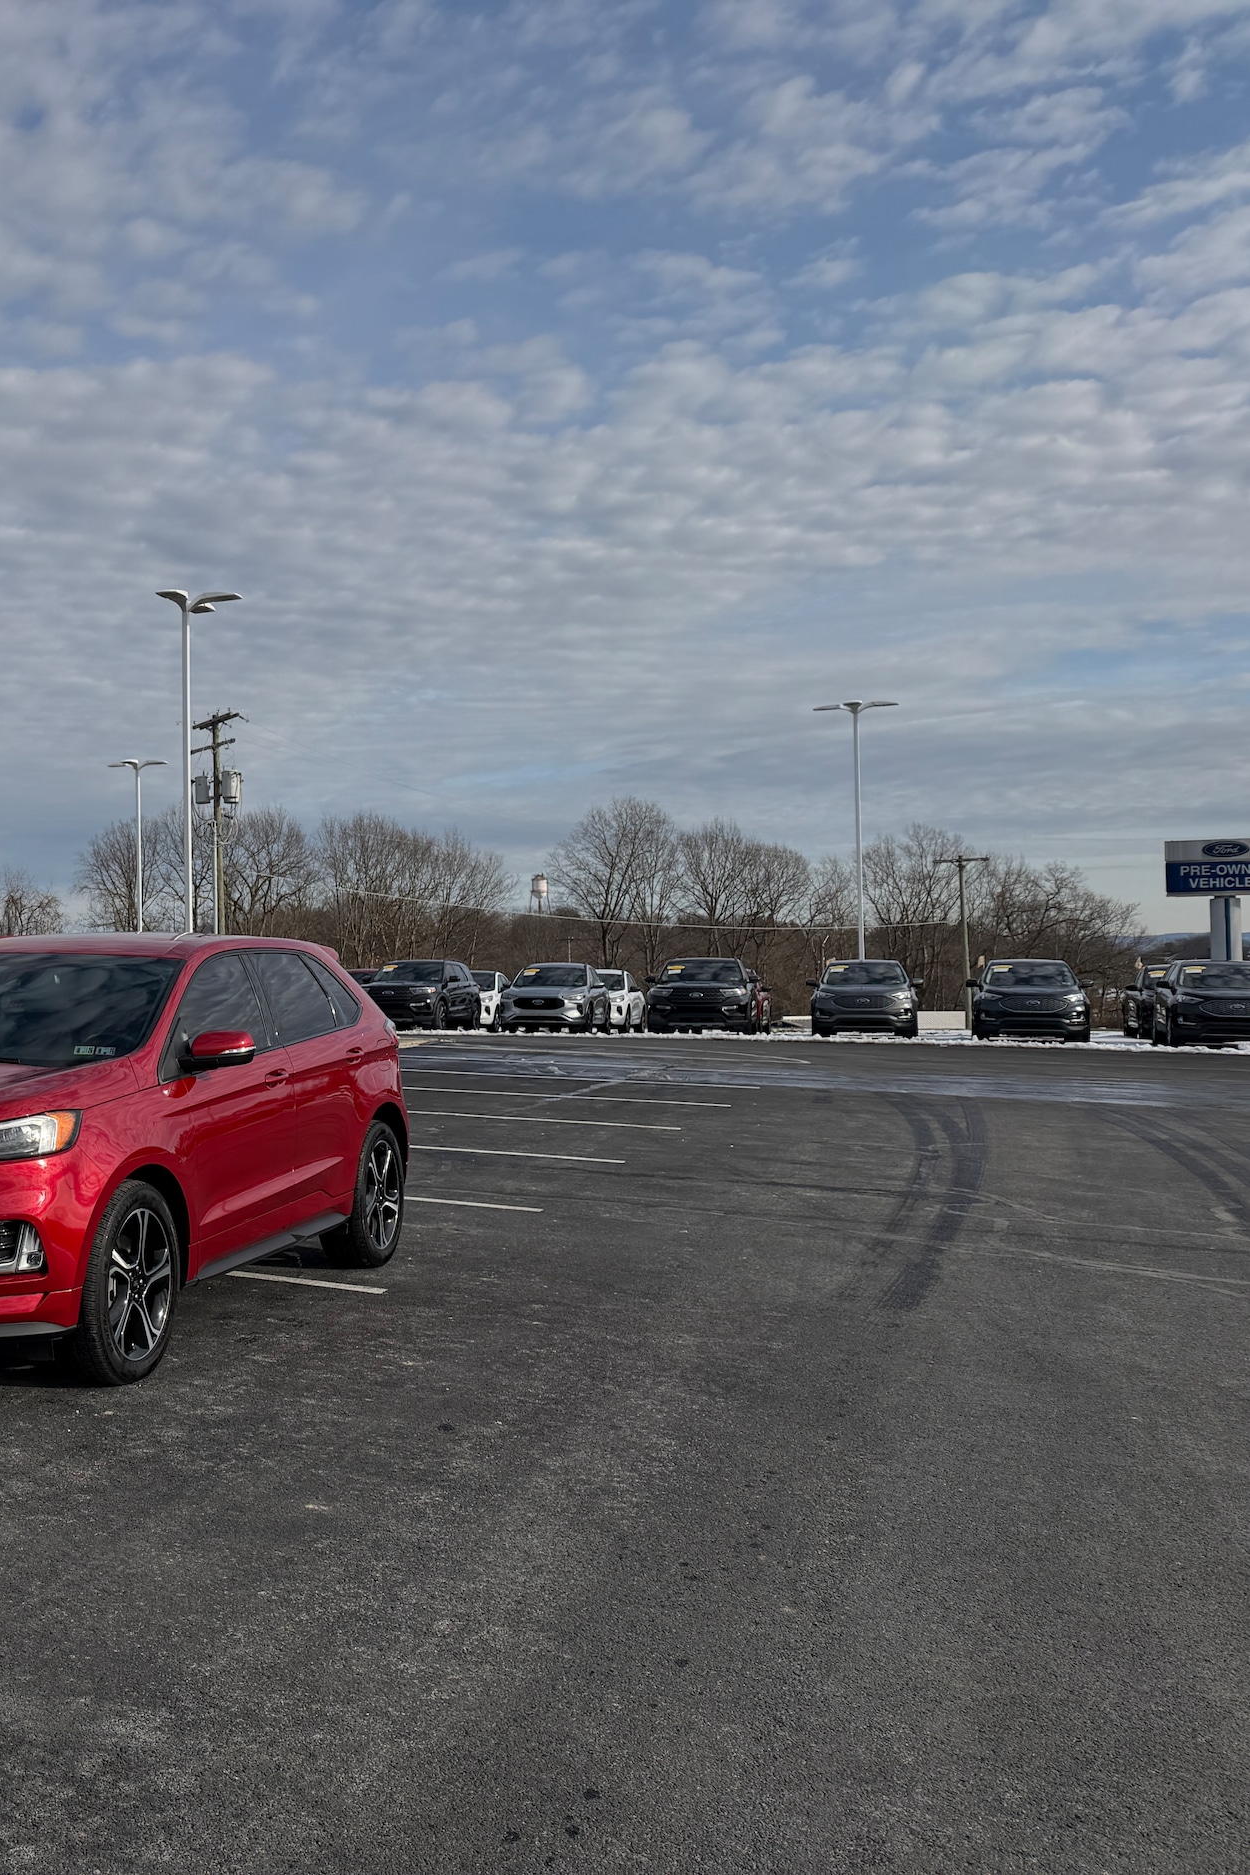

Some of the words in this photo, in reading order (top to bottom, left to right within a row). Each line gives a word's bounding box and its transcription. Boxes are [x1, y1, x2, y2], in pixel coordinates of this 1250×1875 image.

[1212, 844, 1240, 854] Ford
[1180, 864, 1250, 876] PRE-OWN
[1189, 876, 1250, 888] VEHICLE
